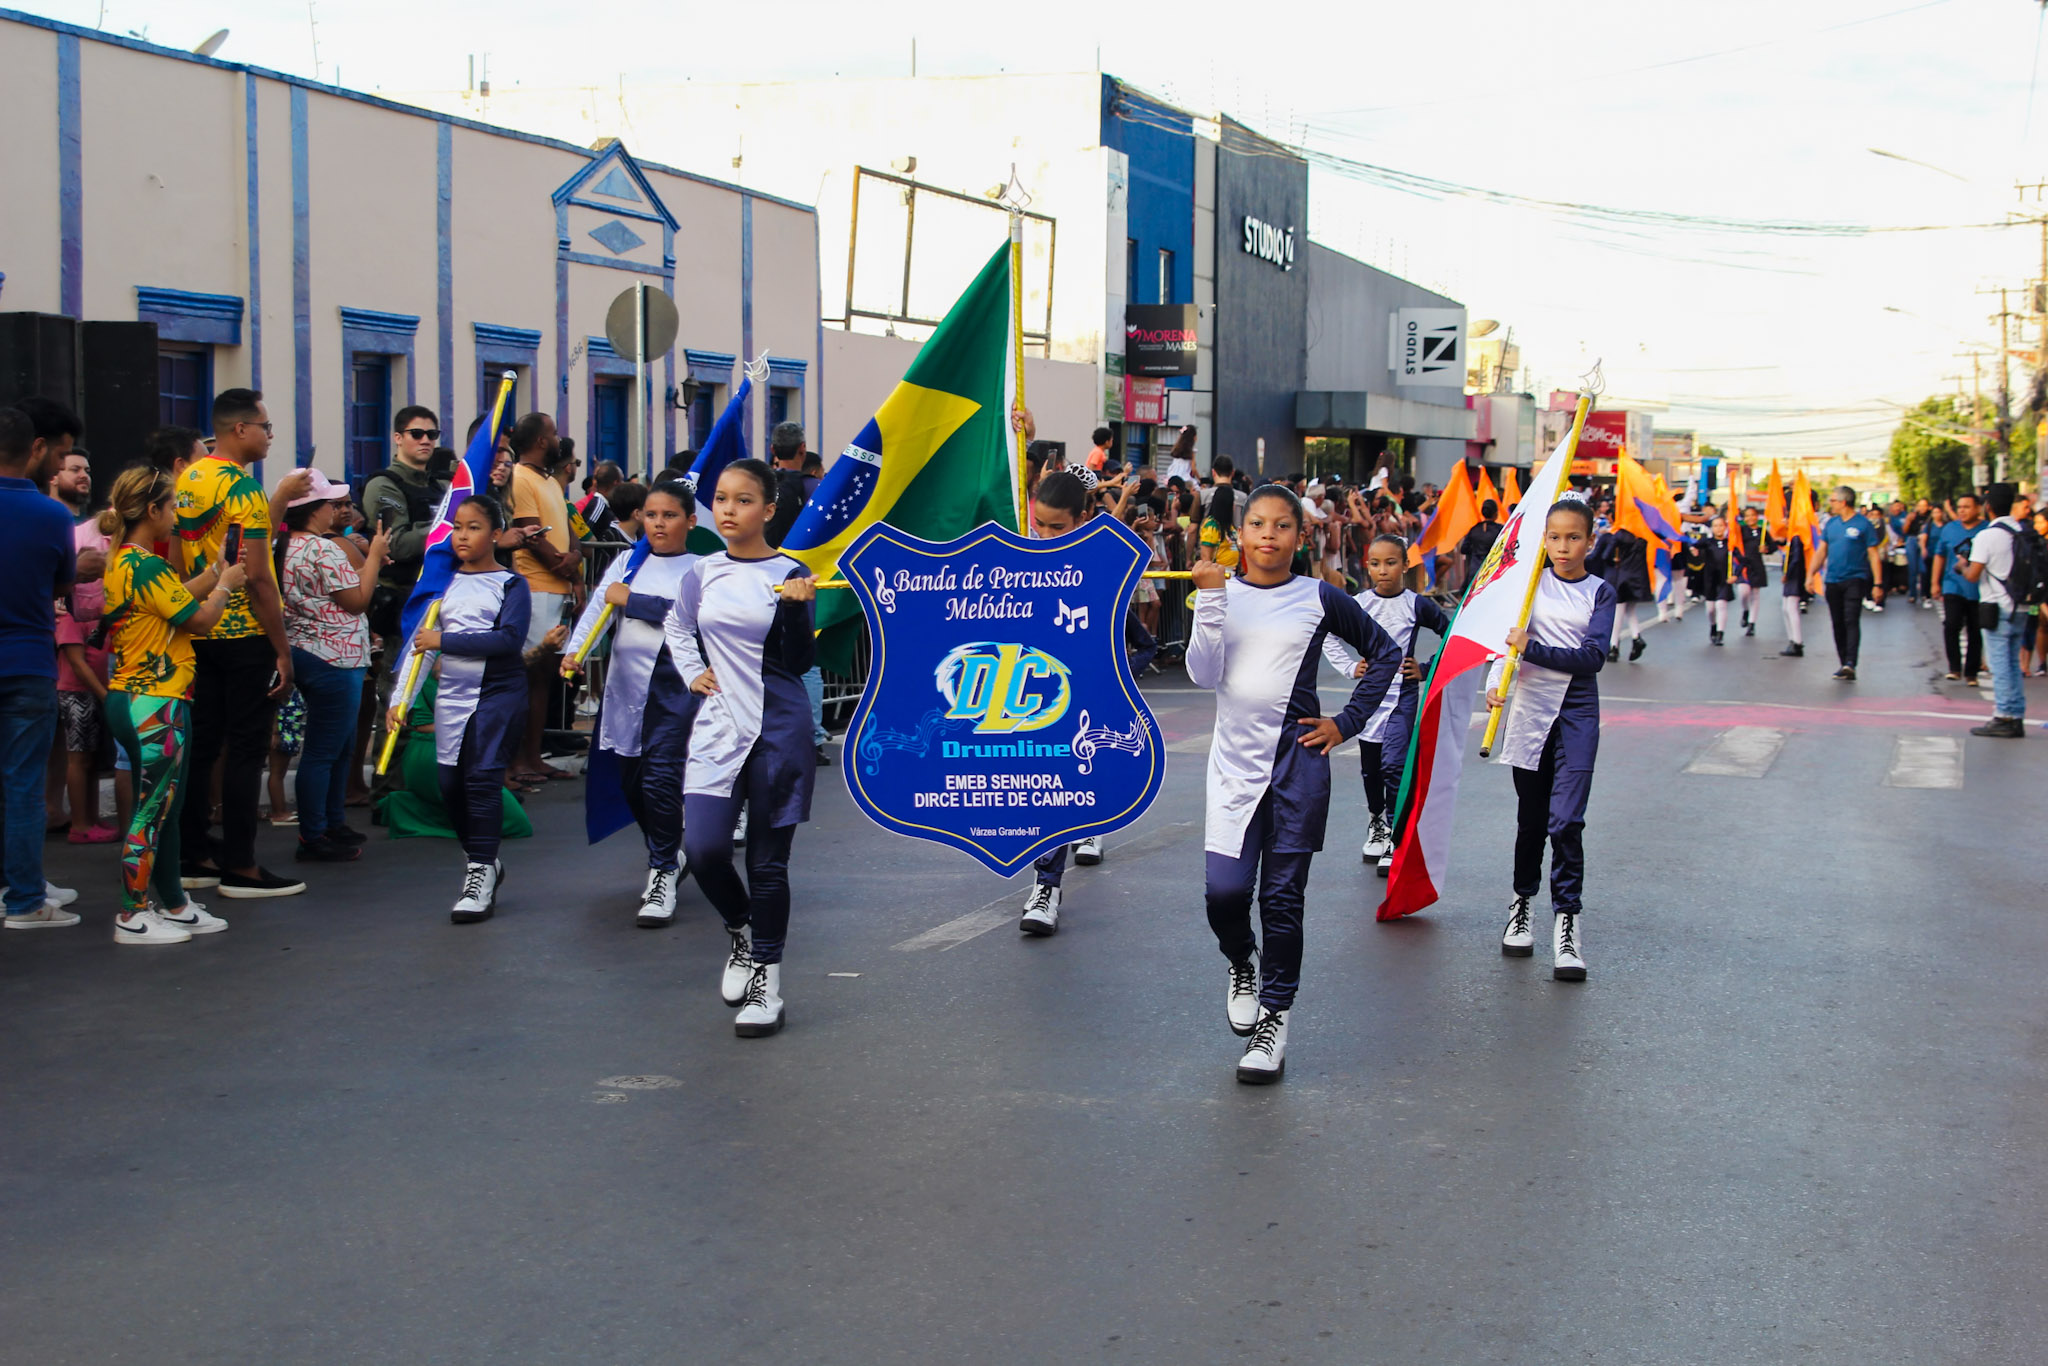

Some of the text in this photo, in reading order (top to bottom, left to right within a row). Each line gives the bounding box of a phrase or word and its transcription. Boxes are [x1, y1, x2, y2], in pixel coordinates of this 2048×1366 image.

[1245, 215, 1284, 266] STUDIO
[1142, 329, 1198, 343] MORENA
[1166, 341, 1197, 352] MAKES
[1406, 321, 1418, 375] STUDIO
[1580, 431, 1624, 446] ROPICAL
[894, 564, 1084, 592] Banda de Percussão
[945, 593, 1033, 620] Melódica
[944, 643, 1050, 734] DLC
[942, 740, 1070, 758] Drumline
[946, 774, 1063, 790] EMEB SENHORA
[914, 791, 1096, 808] DIRCE LEITE DE CAMPOS
[970, 827, 1040, 836] Várzea Grande-MT
